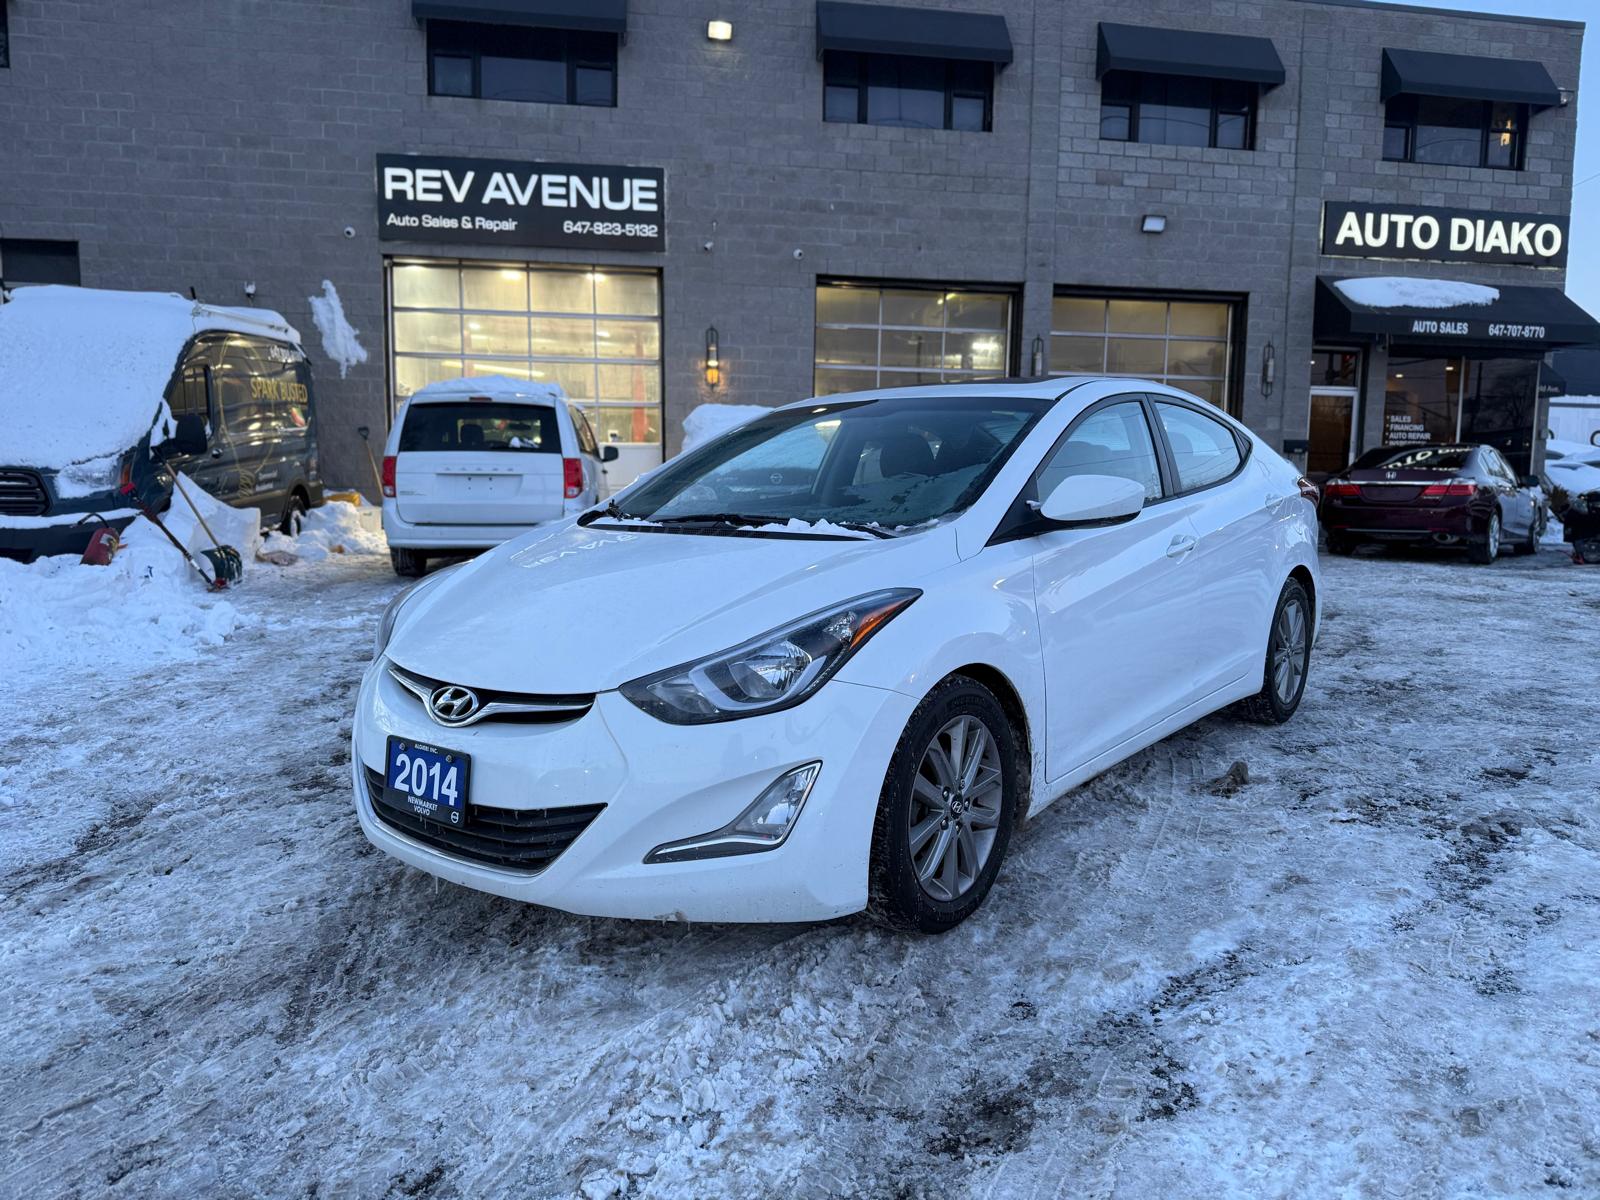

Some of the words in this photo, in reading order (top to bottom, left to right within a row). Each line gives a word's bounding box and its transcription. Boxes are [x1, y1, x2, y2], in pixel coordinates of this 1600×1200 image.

[384, 167, 475, 203] REV
[481, 171, 658, 212] AVENUE
[386, 213, 419, 227] Auto
[422, 214, 458, 229] Sales
[460, 216, 473, 230] &
[475, 216, 518, 233] Repair
[563, 220, 658, 238] 647-823-5132
[1335, 211, 1440, 250] AUTO
[1450, 217, 1562, 257] DIAKO
[1412, 320, 1438, 334] AUTO
[1440, 321, 1469, 335] SALES
[1488, 323, 1545, 338] 647-707-8770
[1390, 415, 1412, 423] SALES
[1389, 423, 1424, 432] FINANCING
[1389, 432, 1407, 440] AUTO
[1407, 432, 1431, 440] REPAIR
[394, 753, 458, 807] 2014
[407, 795, 438, 811] NEWMARKET
[413, 804, 431, 816] VOLVO
